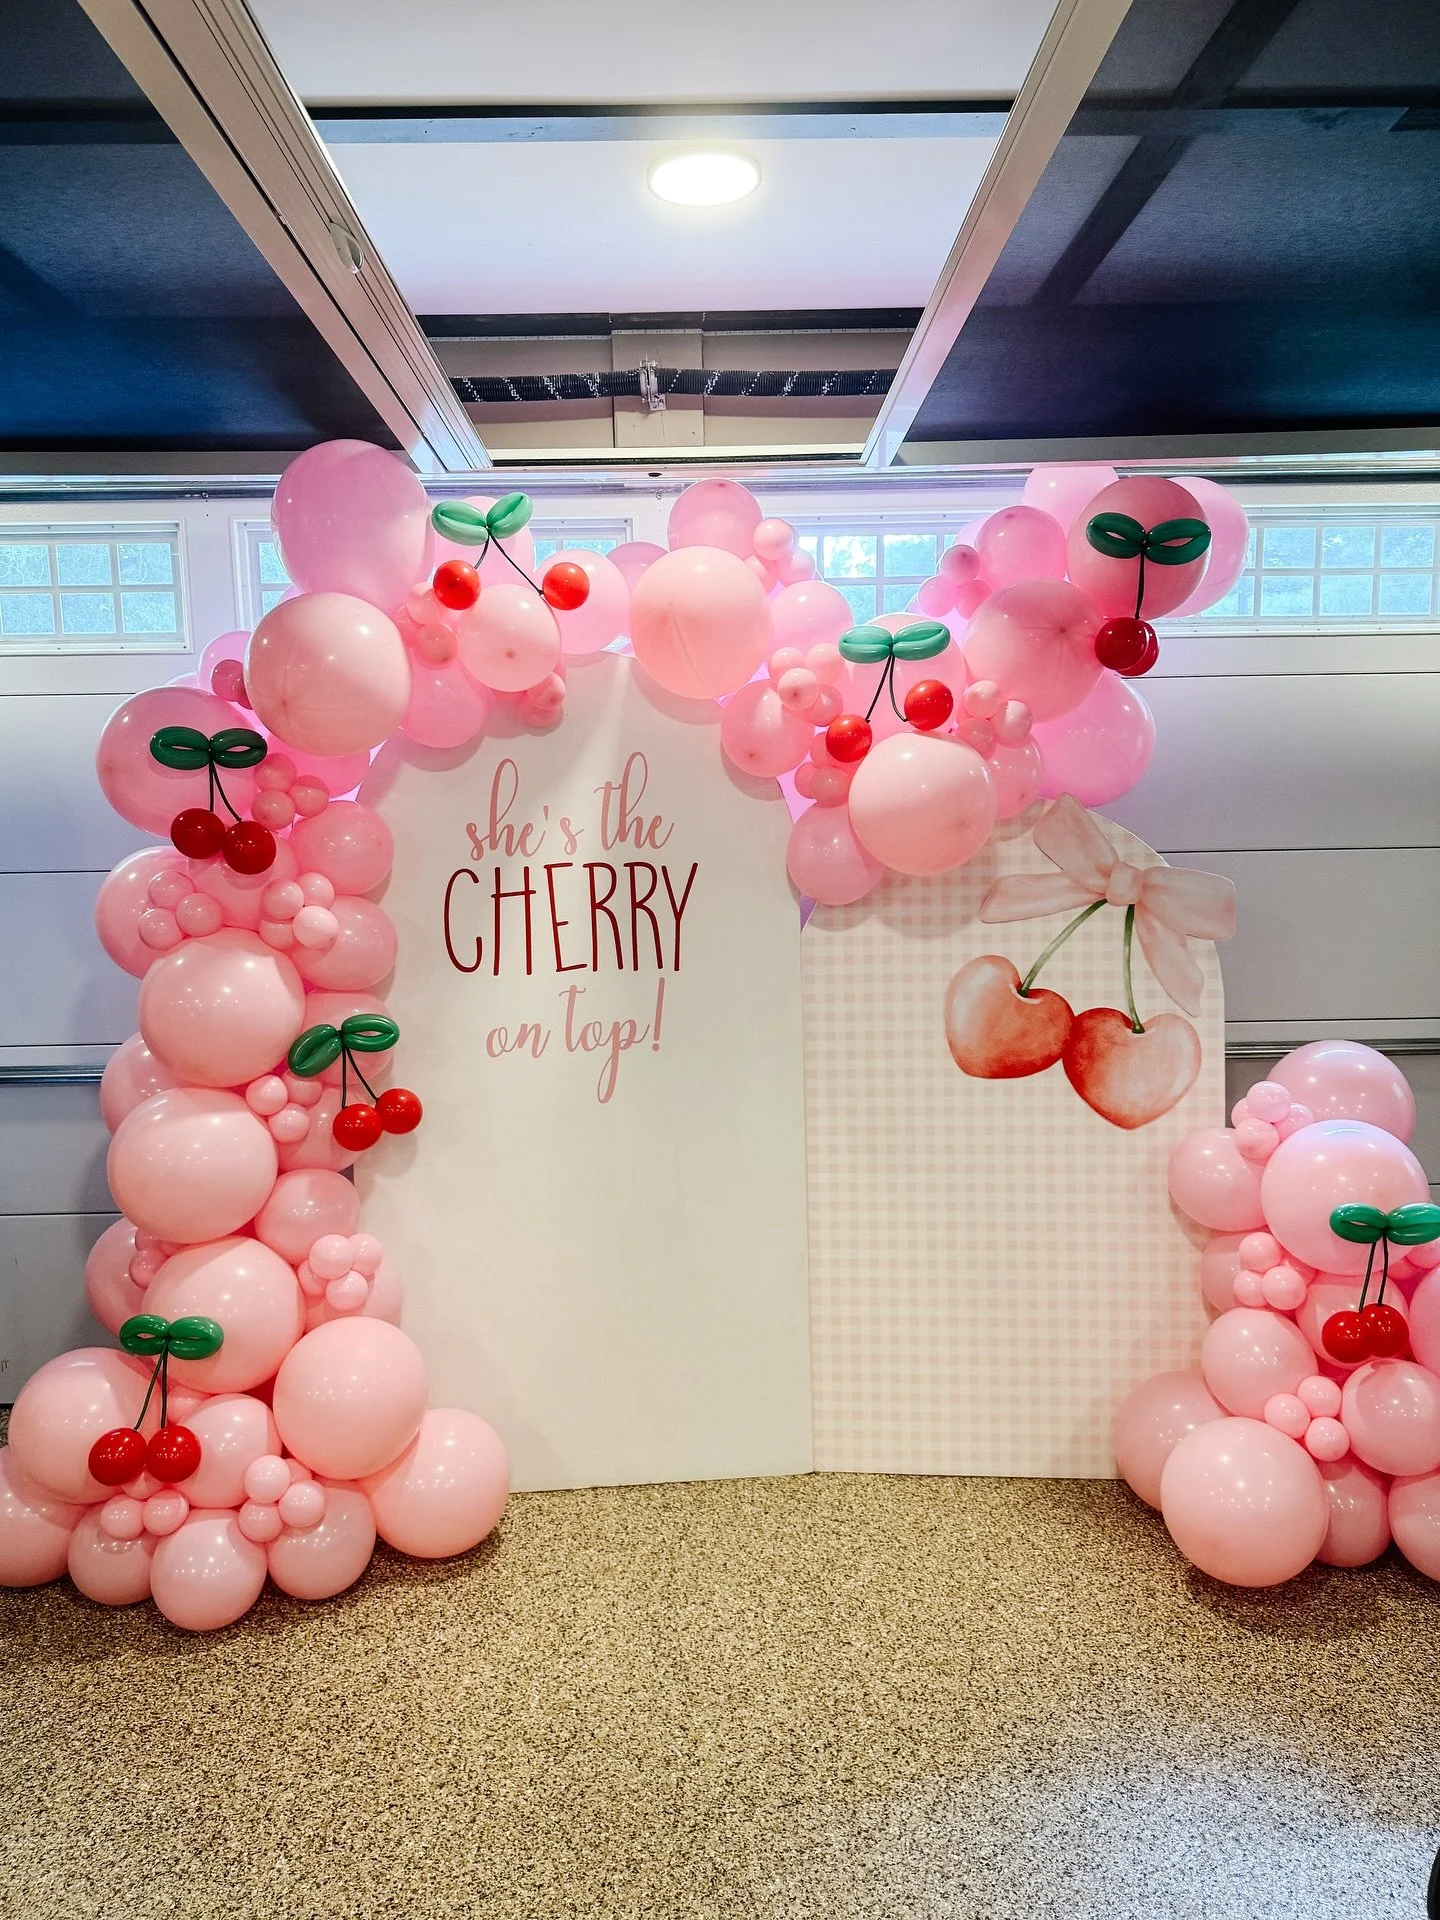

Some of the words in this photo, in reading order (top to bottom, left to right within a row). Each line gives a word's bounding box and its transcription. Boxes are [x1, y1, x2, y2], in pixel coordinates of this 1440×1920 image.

[466, 759, 584, 861] she's
[593, 752, 675, 850] the
[444, 862, 699, 976] CHERRY
[486, 1023, 551, 1058] on
[559, 977, 666, 1104] top!
